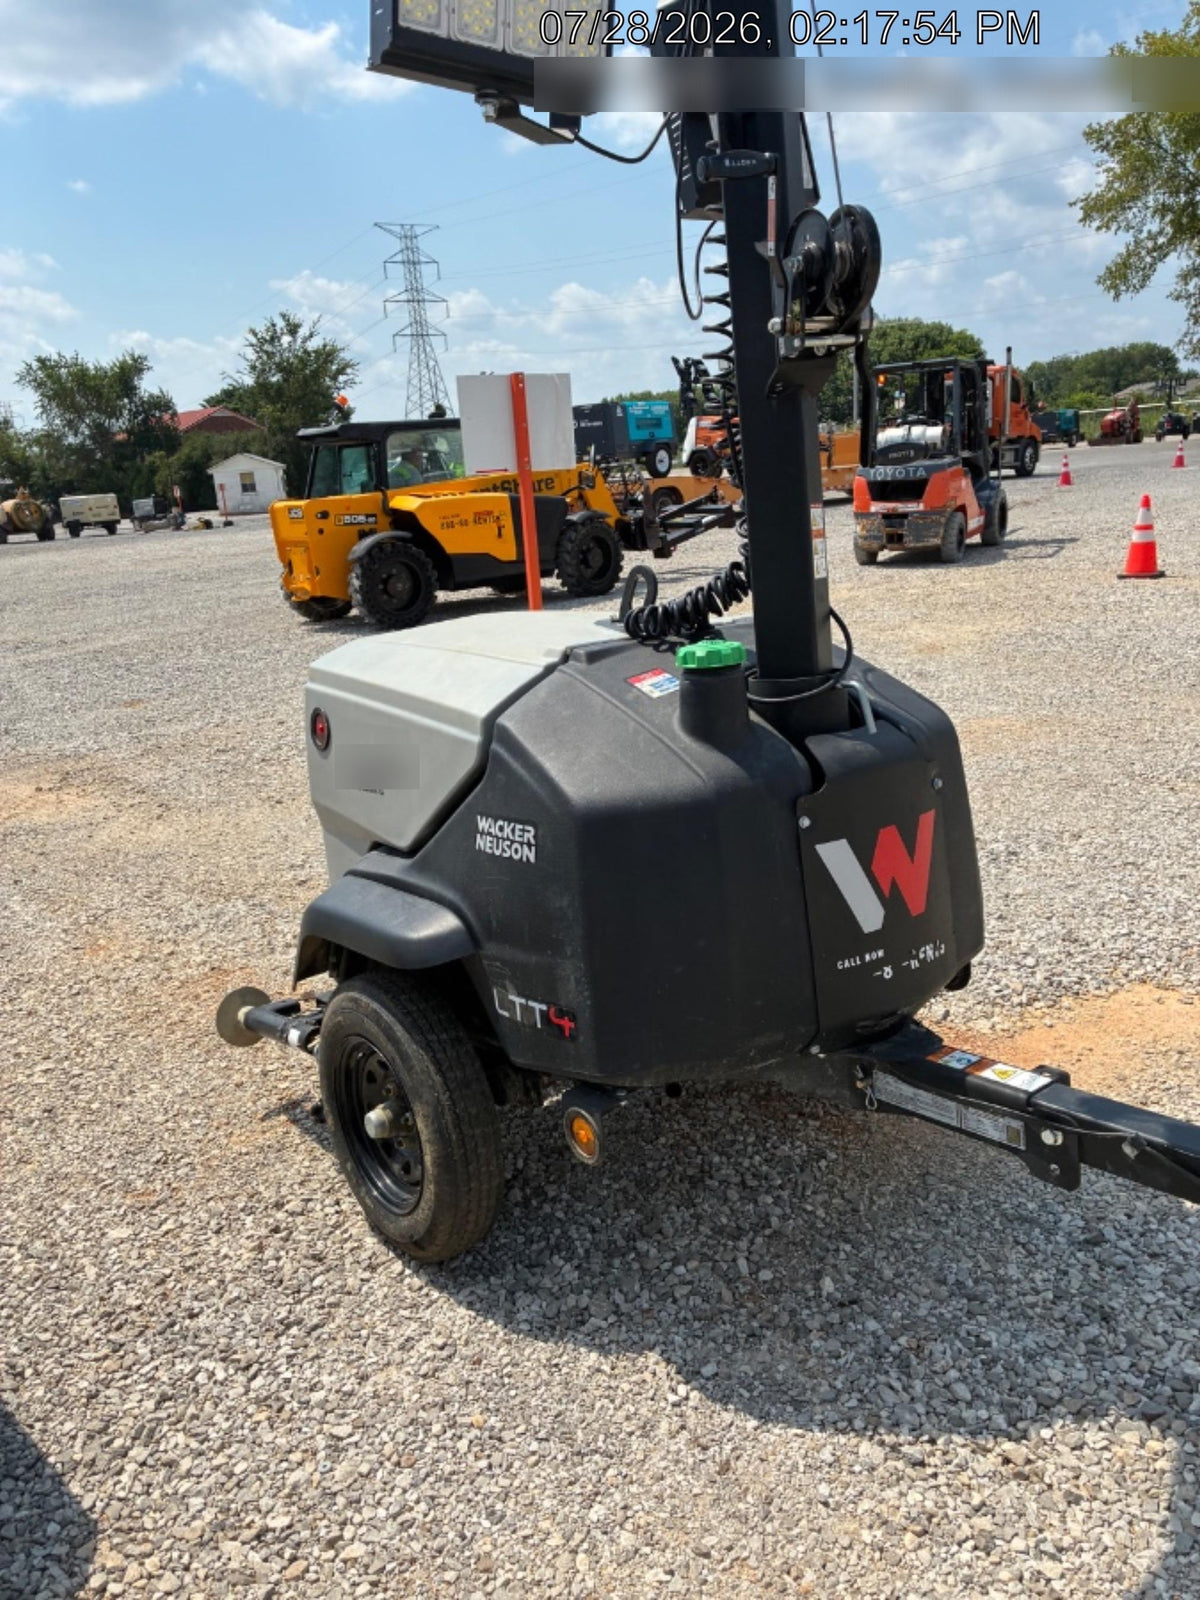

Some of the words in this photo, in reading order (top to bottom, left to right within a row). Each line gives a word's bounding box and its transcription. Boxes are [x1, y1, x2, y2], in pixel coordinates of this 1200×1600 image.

[870, 466, 927, 480] TOYOTA
[477, 815, 535, 844] WACKER
[475, 834, 536, 864] NEUSON
[836, 956, 861, 970] CALL
[493, 988, 576, 1037] LTT4
